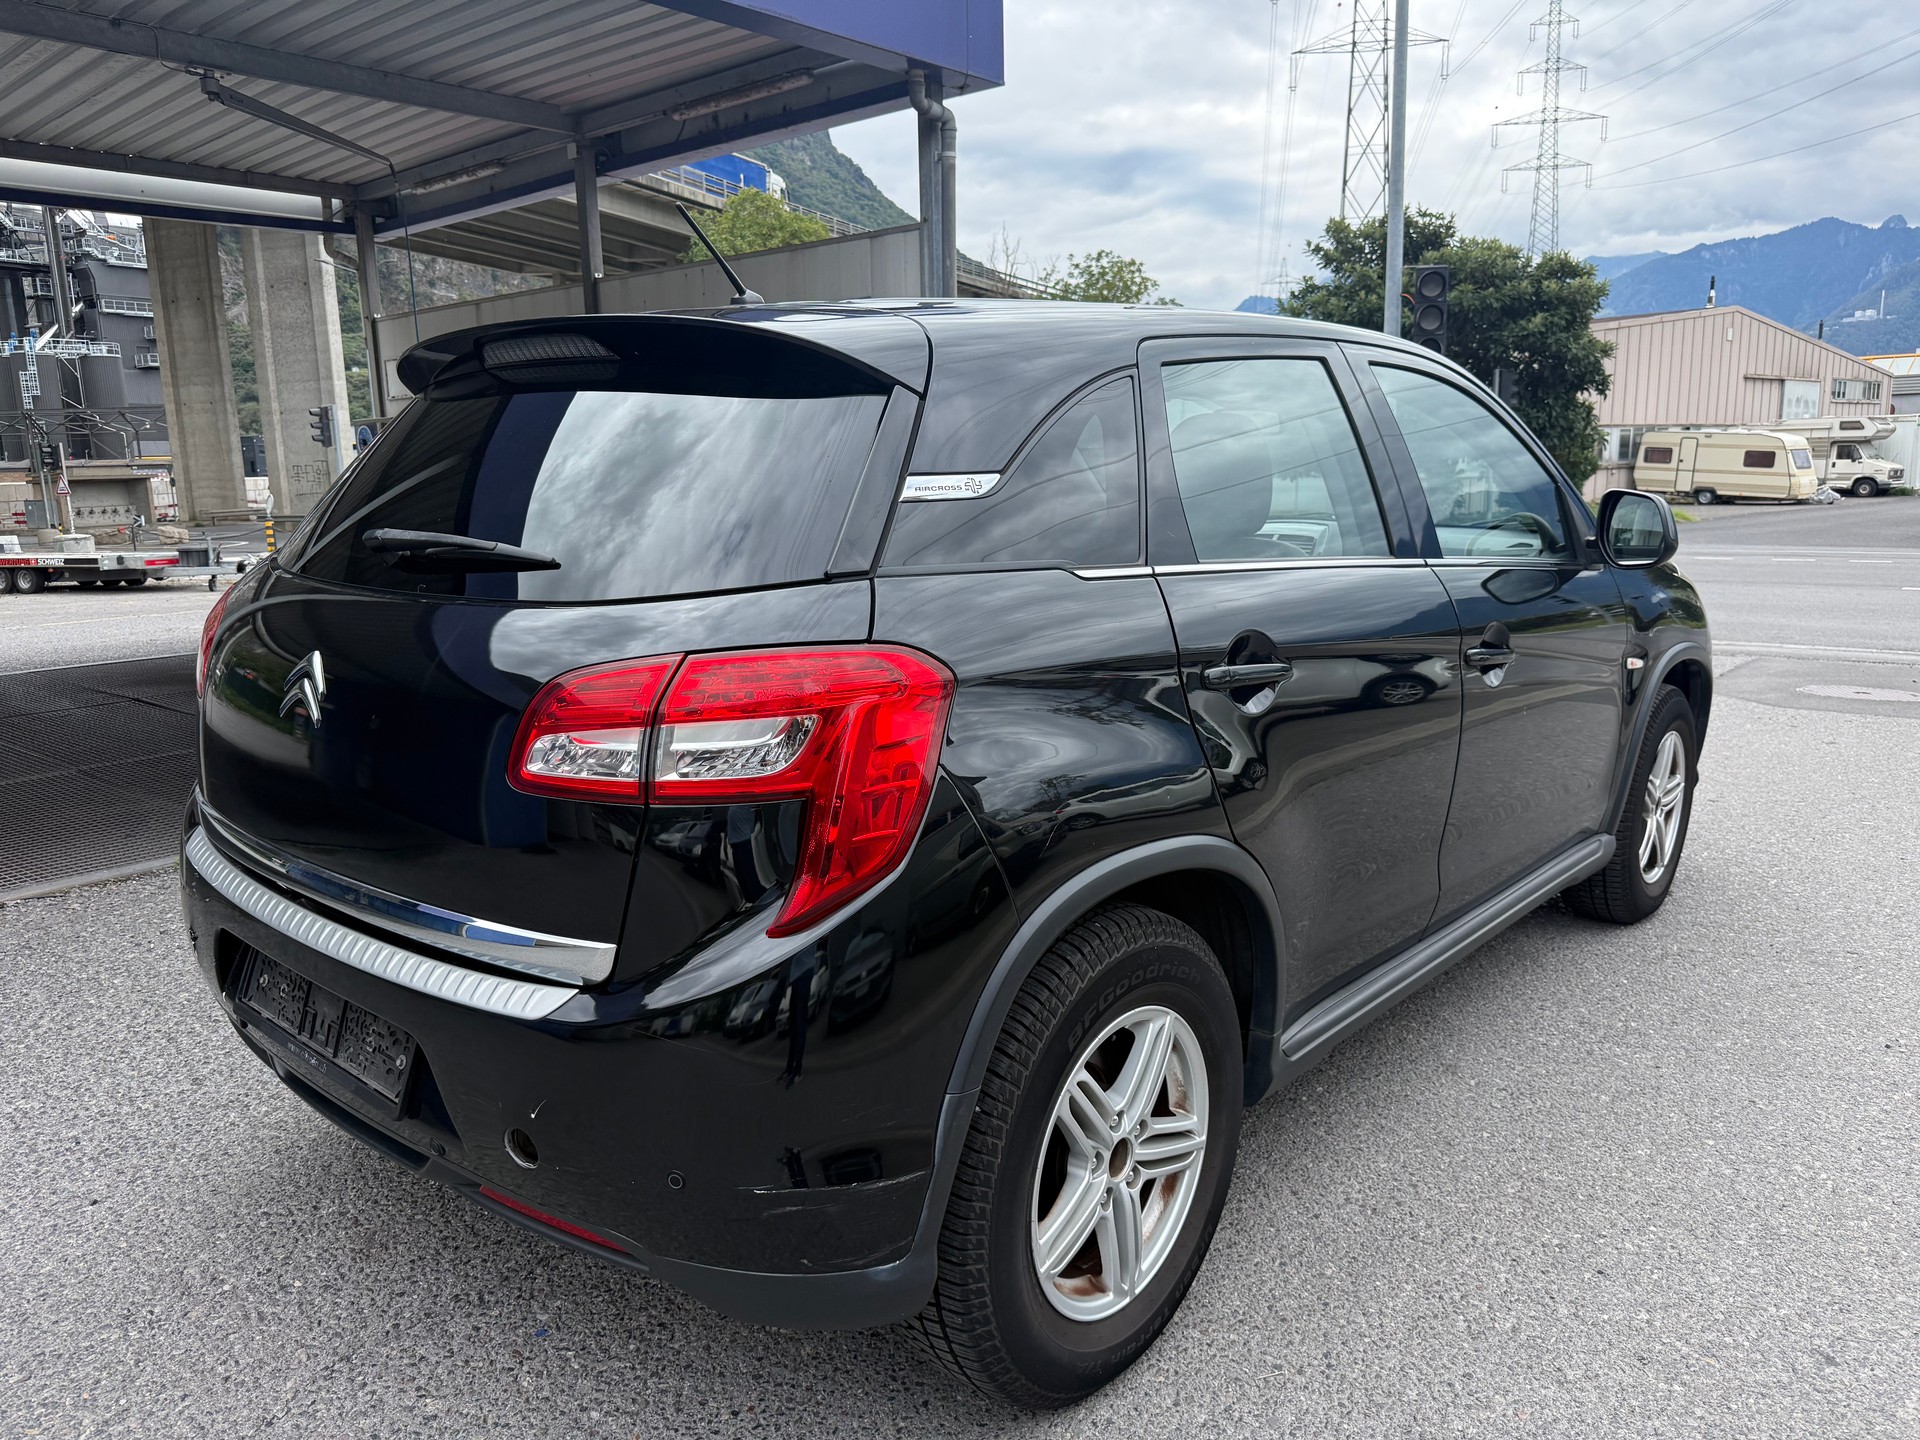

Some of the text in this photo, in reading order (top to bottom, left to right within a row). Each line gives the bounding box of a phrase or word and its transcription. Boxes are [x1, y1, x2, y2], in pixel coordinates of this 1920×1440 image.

[914, 484, 963, 492] AIRCROSS
[37, 558, 65, 566] SCHWEIZ
[1067, 961, 1200, 1052] BFGoodrich
